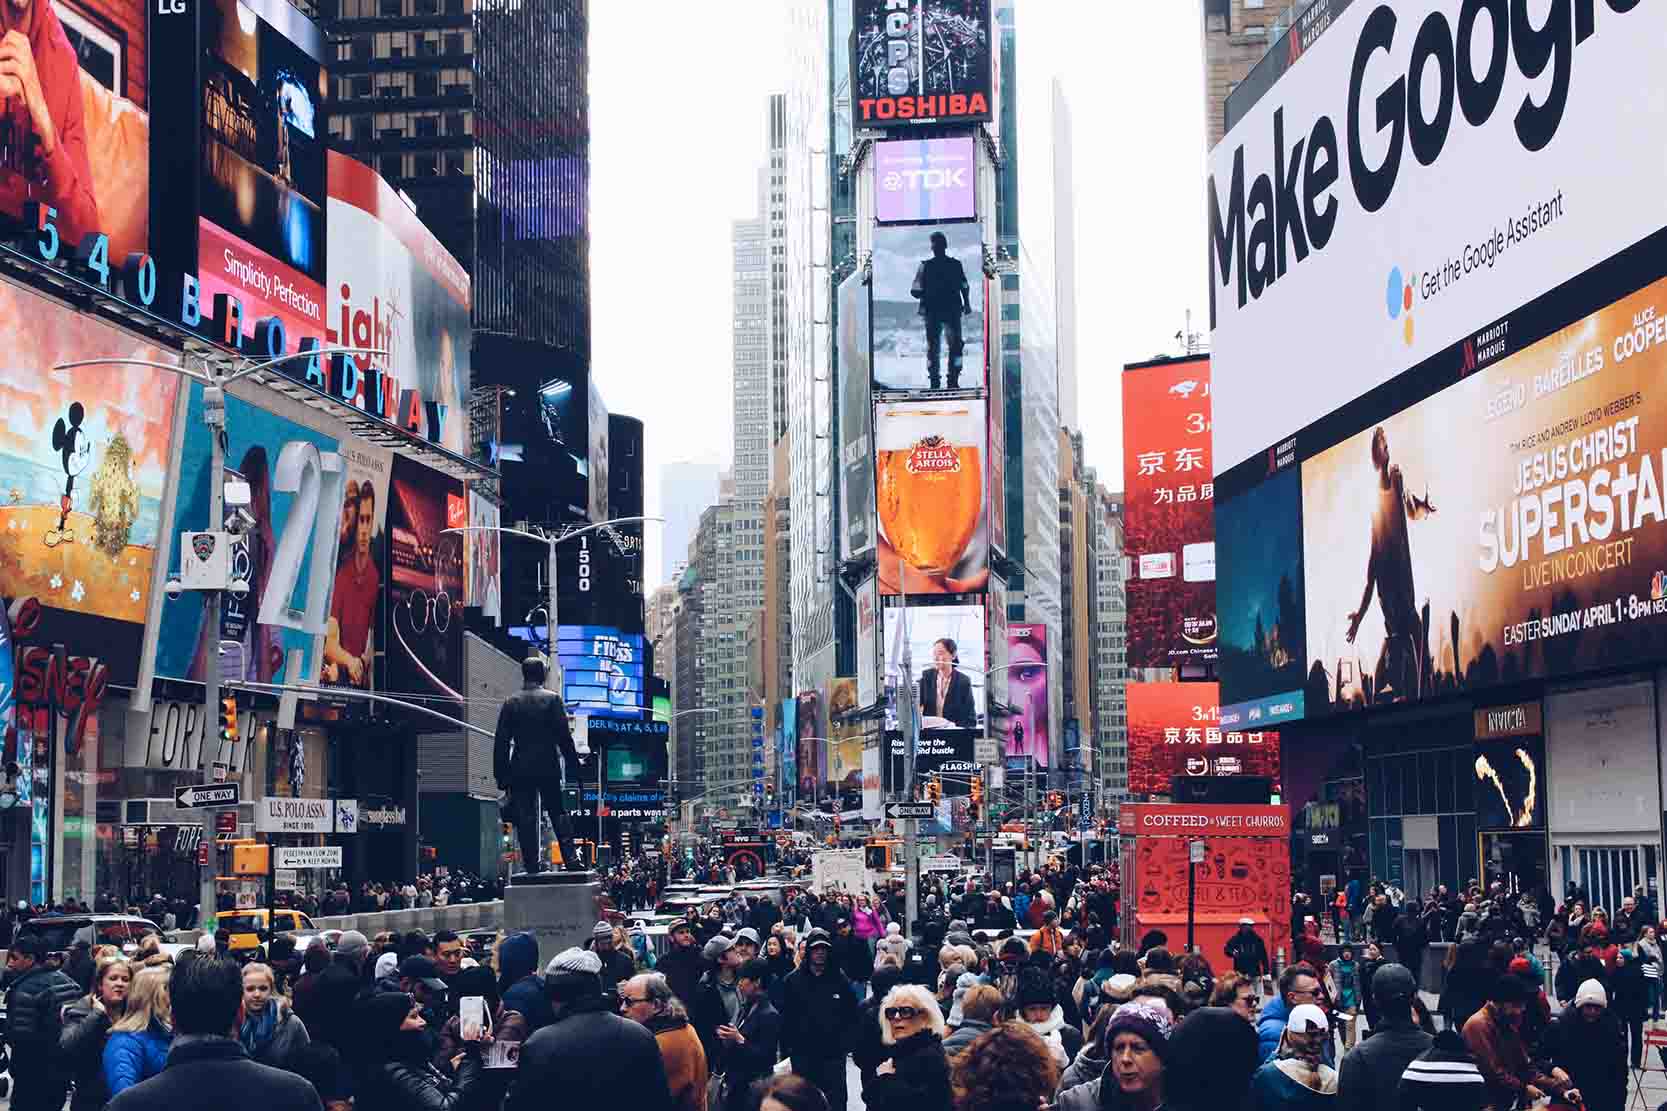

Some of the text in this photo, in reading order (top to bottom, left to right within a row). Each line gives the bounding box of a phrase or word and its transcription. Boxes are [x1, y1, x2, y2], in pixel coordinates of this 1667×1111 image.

[158, 0, 186, 14] LG
[859, 91, 988, 120] TOSHIBA
[1208, 0, 1641, 332] Make Goog
[1421, 188, 1563, 300] Get the Google Assistant
[223, 248, 272, 298] Simplicity.
[1633, 305, 1656, 327] ALICE
[1477, 320, 1509, 347] MARRIOTT
[1477, 340, 1505, 364] MARQUIS
[1537, 427, 1551, 445] AND
[1551, 416, 1580, 440] ANDREW
[1580, 407, 1602, 429] LLOYD
[1603, 390, 1643, 417] WEBBER'S
[916, 450, 952, 459] STELLA
[916, 459, 953, 468] ARTOIS
[1513, 415, 1640, 495] JESUS CHRIST
[579, 535, 591, 592] 1500
[1522, 536, 1635, 591] LIVE IN CONCERT
[1503, 619, 1541, 646] EASTER
[1542, 608, 1583, 638] SUNDAY
[1583, 603, 1616, 629] APRIL
[1487, 706, 1527, 733] INVICTA
[933, 738, 946, 746] the
[193, 789, 232, 801] ONE WAY
[269, 800, 284, 818] U.S.
[285, 801, 306, 819] POLO
[617, 808, 641, 818] parts
[899, 806, 929, 814] ONE WAY
[1143, 814, 1209, 827] COFFEED
[1215, 814, 1243, 828] SWEET
[1245, 814, 1285, 828] CHURROS
